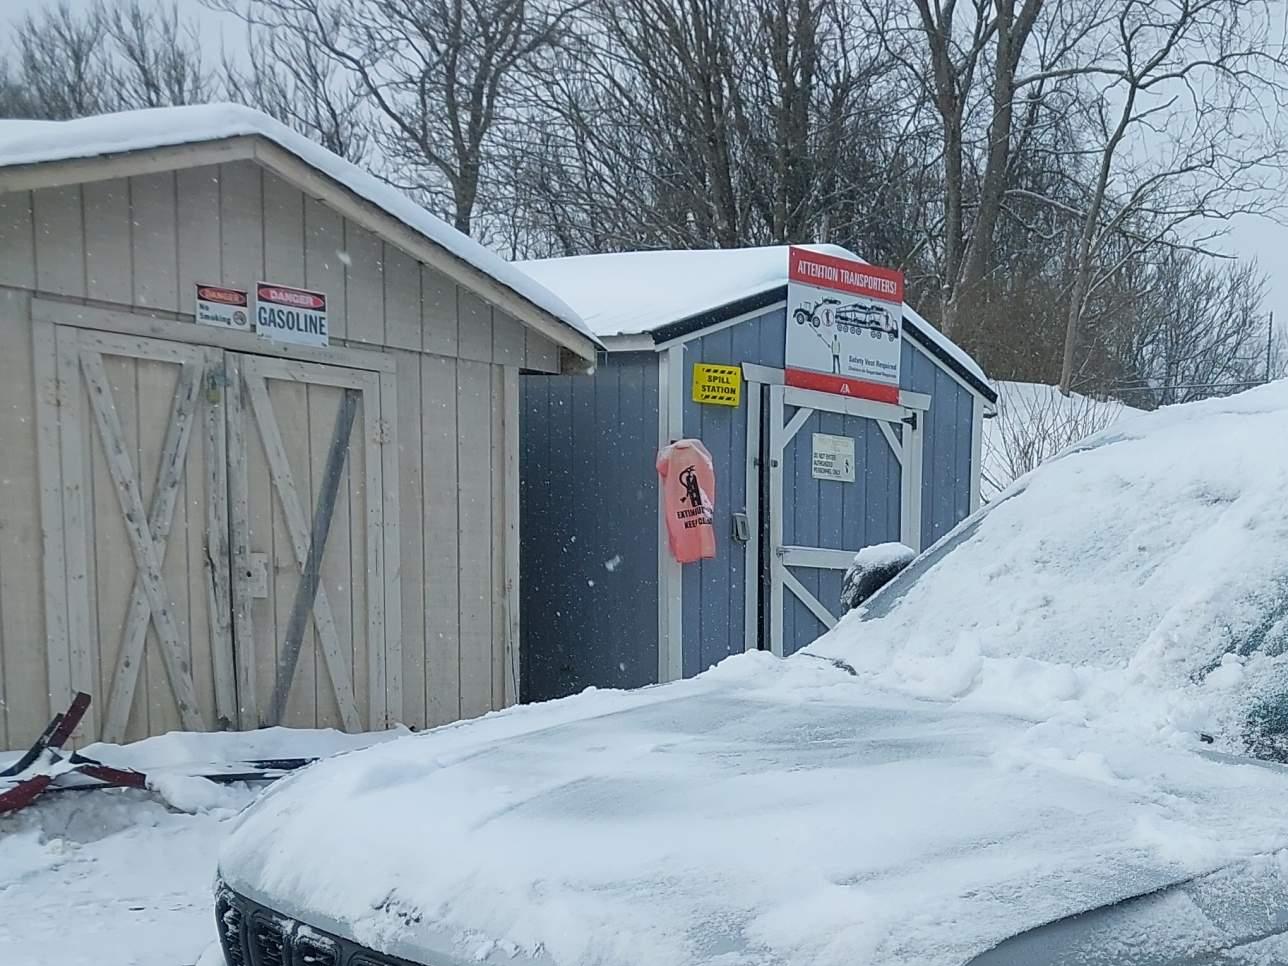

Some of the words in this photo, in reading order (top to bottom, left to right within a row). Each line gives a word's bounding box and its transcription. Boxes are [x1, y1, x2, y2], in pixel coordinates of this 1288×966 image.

[797, 260, 839, 283] ATTENTION
[840, 269, 897, 295] TRANSPORTERS!
[269, 289, 314, 306] DANGER
[199, 303, 209, 311] No
[199, 312, 231, 325] Smoking
[258, 306, 327, 335] GASOLINE
[707, 375, 730, 385] SPILL
[701, 384, 736, 395] STATION
